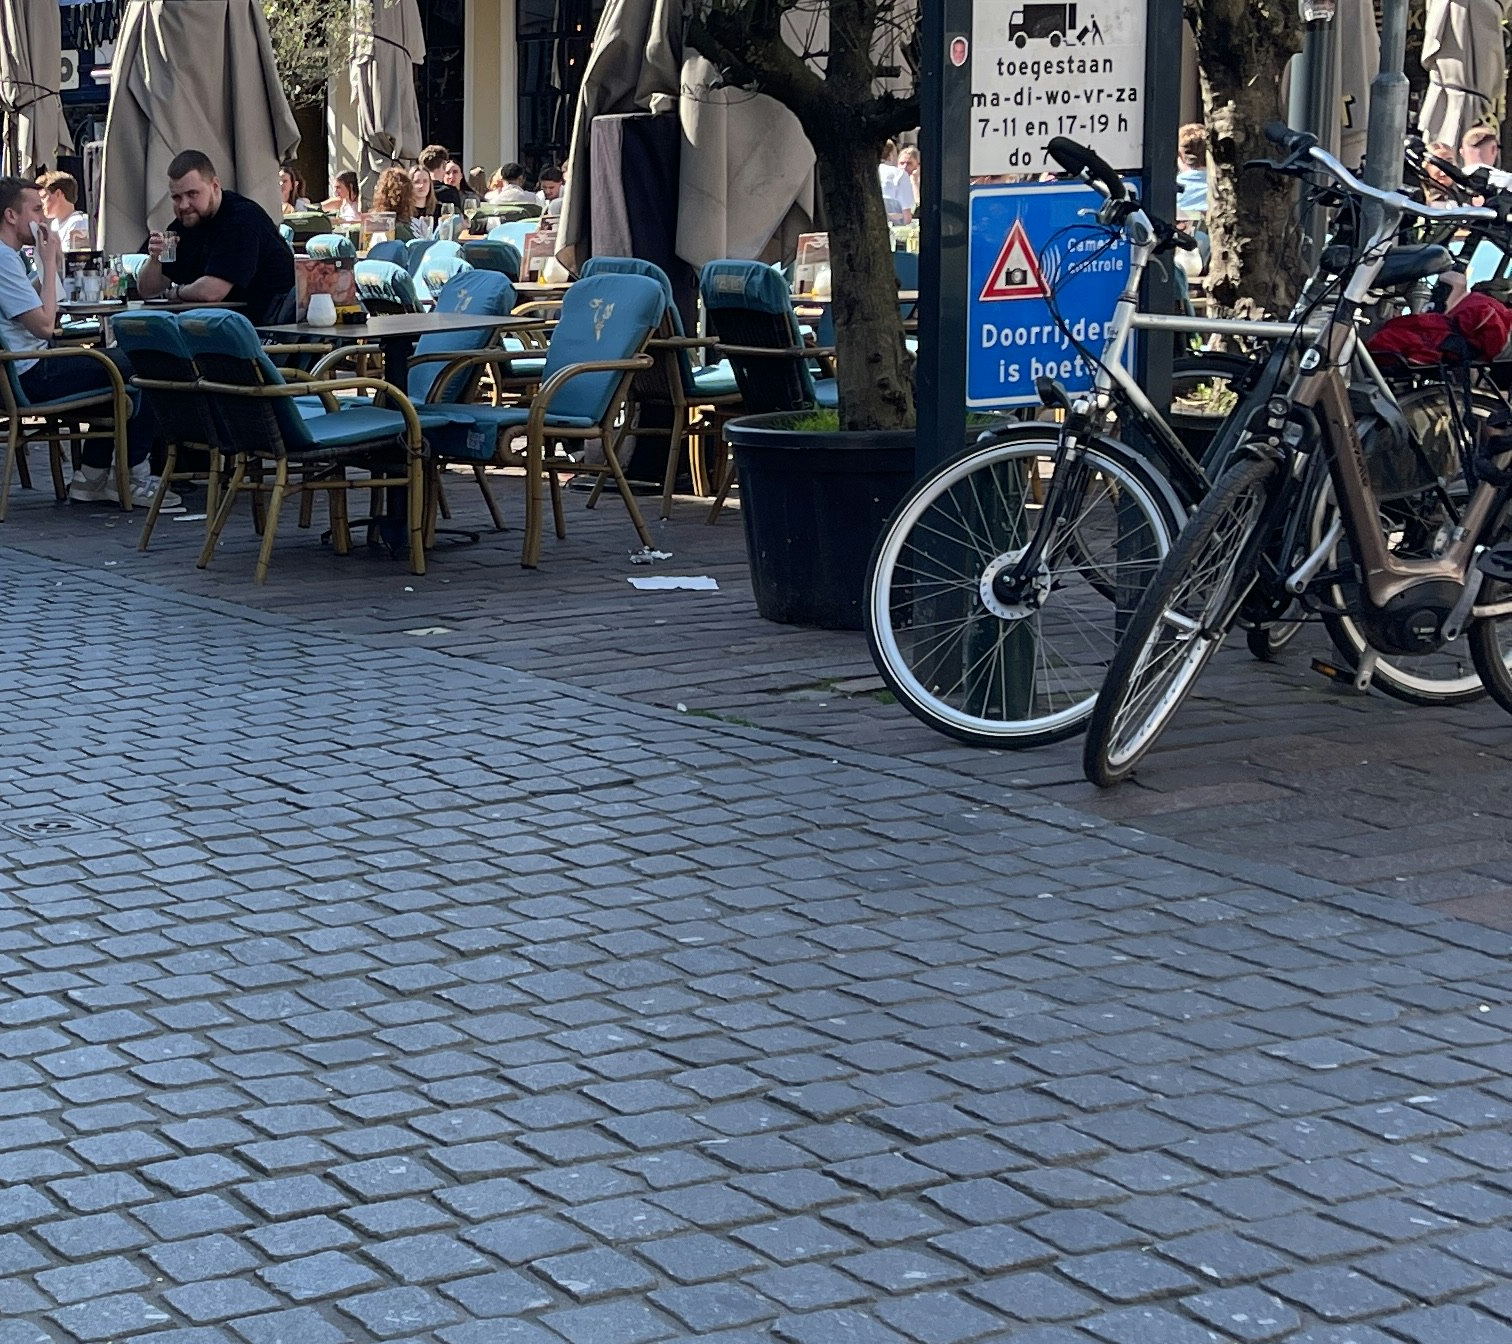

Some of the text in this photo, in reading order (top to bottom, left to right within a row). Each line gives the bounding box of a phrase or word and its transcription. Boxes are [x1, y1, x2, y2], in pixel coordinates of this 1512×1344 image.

[996, 56, 1114, 82] toegestaan
[971, 86, 1138, 108] ma-di-wo-vr-za
[978, 112, 1128, 138] 7-11 en 17-19 h
[1008, 147, 1032, 167] do
[999, 359, 1021, 384] is
